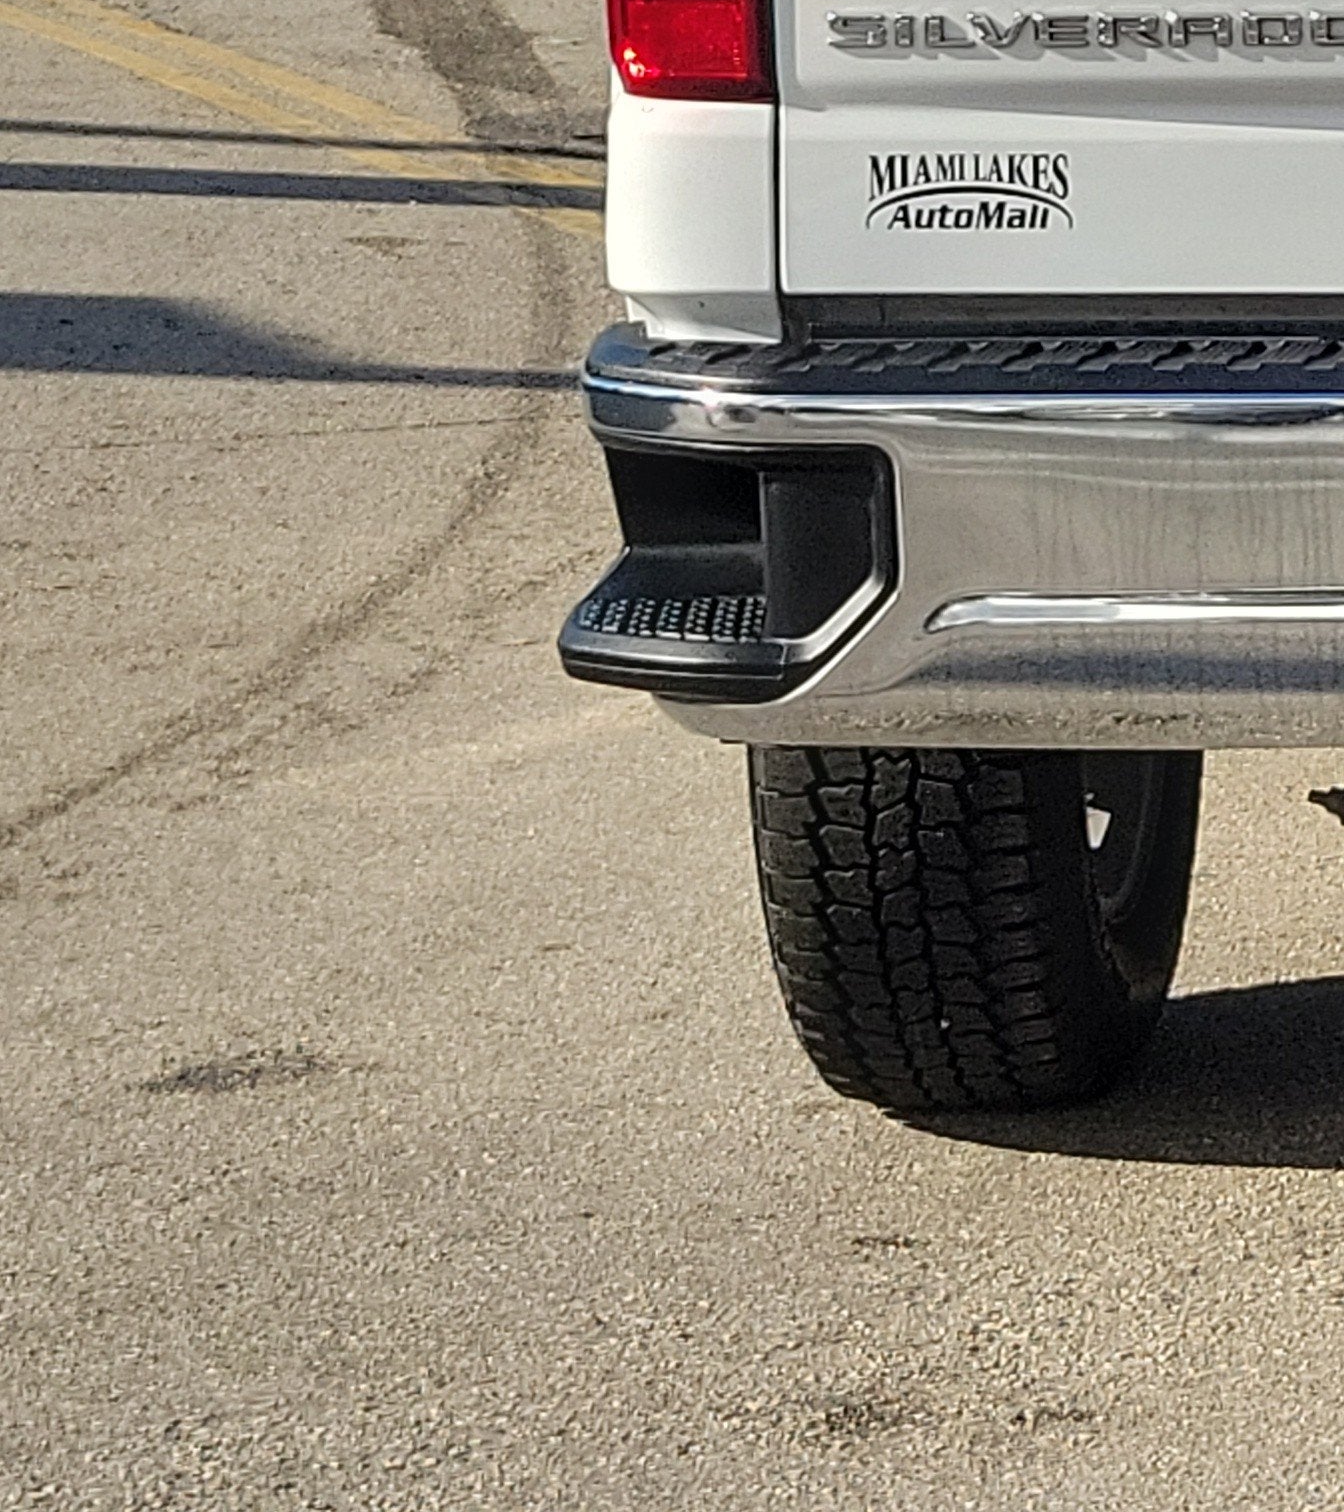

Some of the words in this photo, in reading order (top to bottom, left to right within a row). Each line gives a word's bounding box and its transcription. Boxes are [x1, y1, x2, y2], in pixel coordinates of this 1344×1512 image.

[868, 153, 966, 202] MIAMI
[972, 152, 1070, 201] LAKES
[886, 200, 1050, 230] AutoMall
